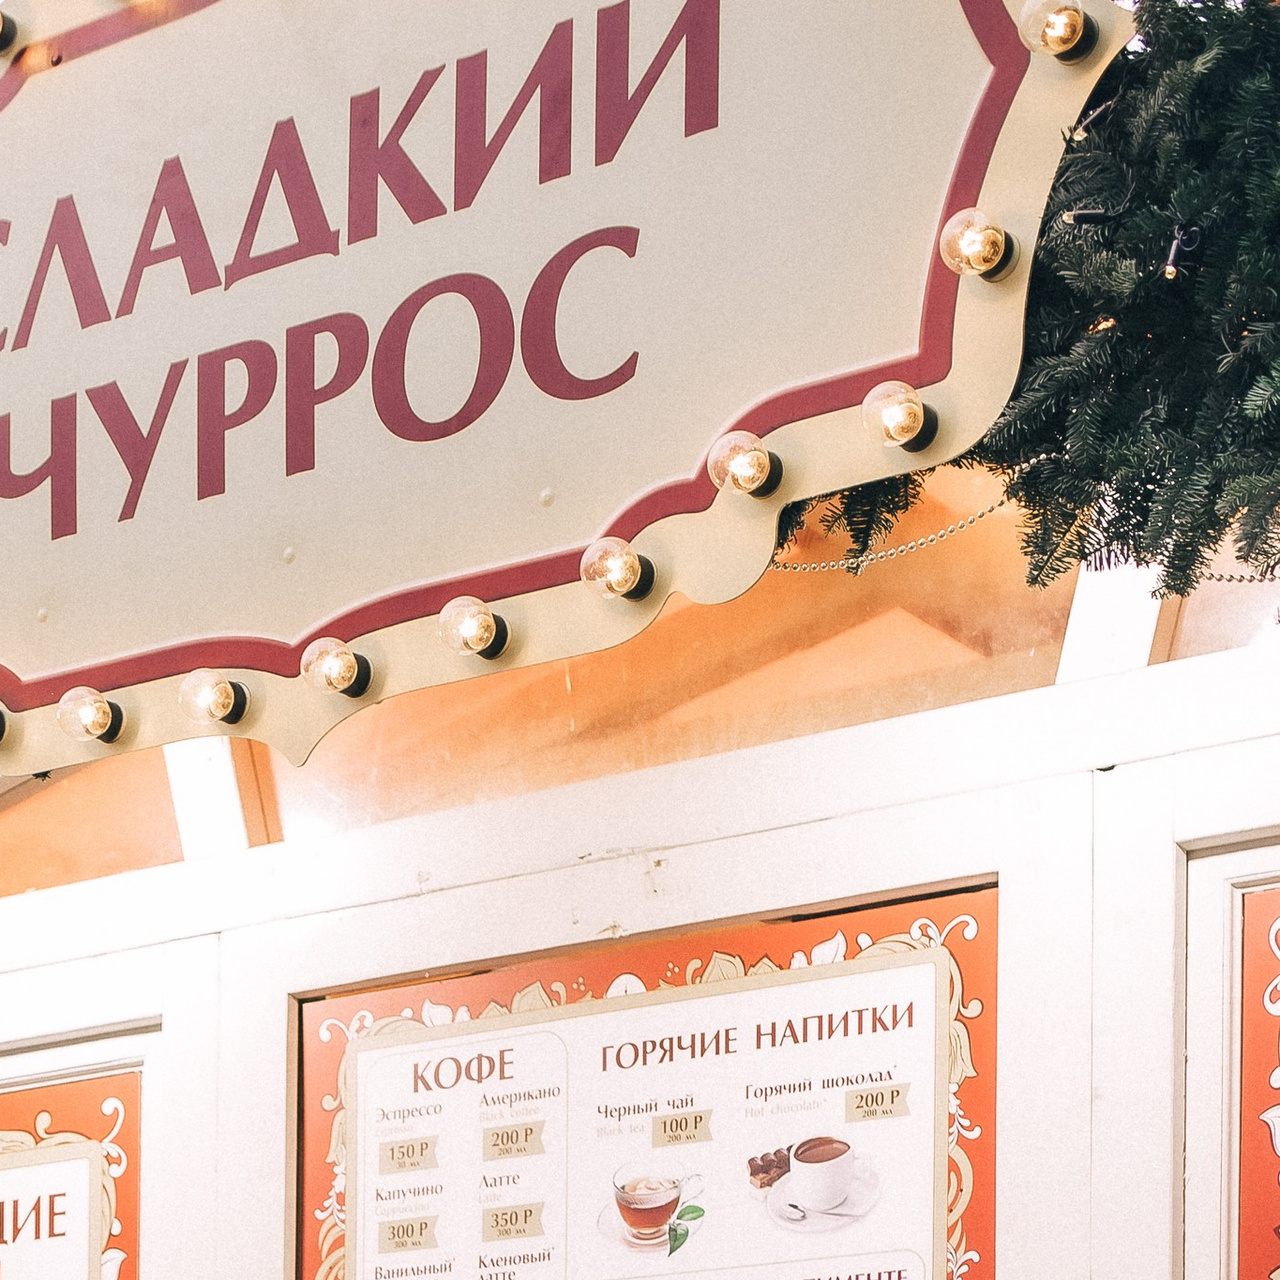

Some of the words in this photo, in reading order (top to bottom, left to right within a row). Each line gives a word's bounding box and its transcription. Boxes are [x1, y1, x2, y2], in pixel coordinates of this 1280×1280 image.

[601, 1027, 739, 1072] ГОРЯЧИЕ
[755, 1001, 914, 1050] НАПИТКИ
[413, 1048, 514, 1093] КОФЕ
[480, 1086, 561, 1108] Американо
[745, 1078, 813, 1102] Горячий
[597, 1097, 659, 1123] Черный
[666, 1093, 694, 1110] чай
[854, 1091, 885, 1110] 200
[376, 1103, 443, 1123] Эспрессо
[660, 1116, 689, 1134] 100
[491, 1129, 519, 1147] 200
[389, 1144, 415, 1160] 150
[480, 1173, 520, 1189] Латте
[375, 1184, 443, 1203] Капучино
[490, 1210, 519, 1228] 350
[388, 1223, 415, 1241] 300
